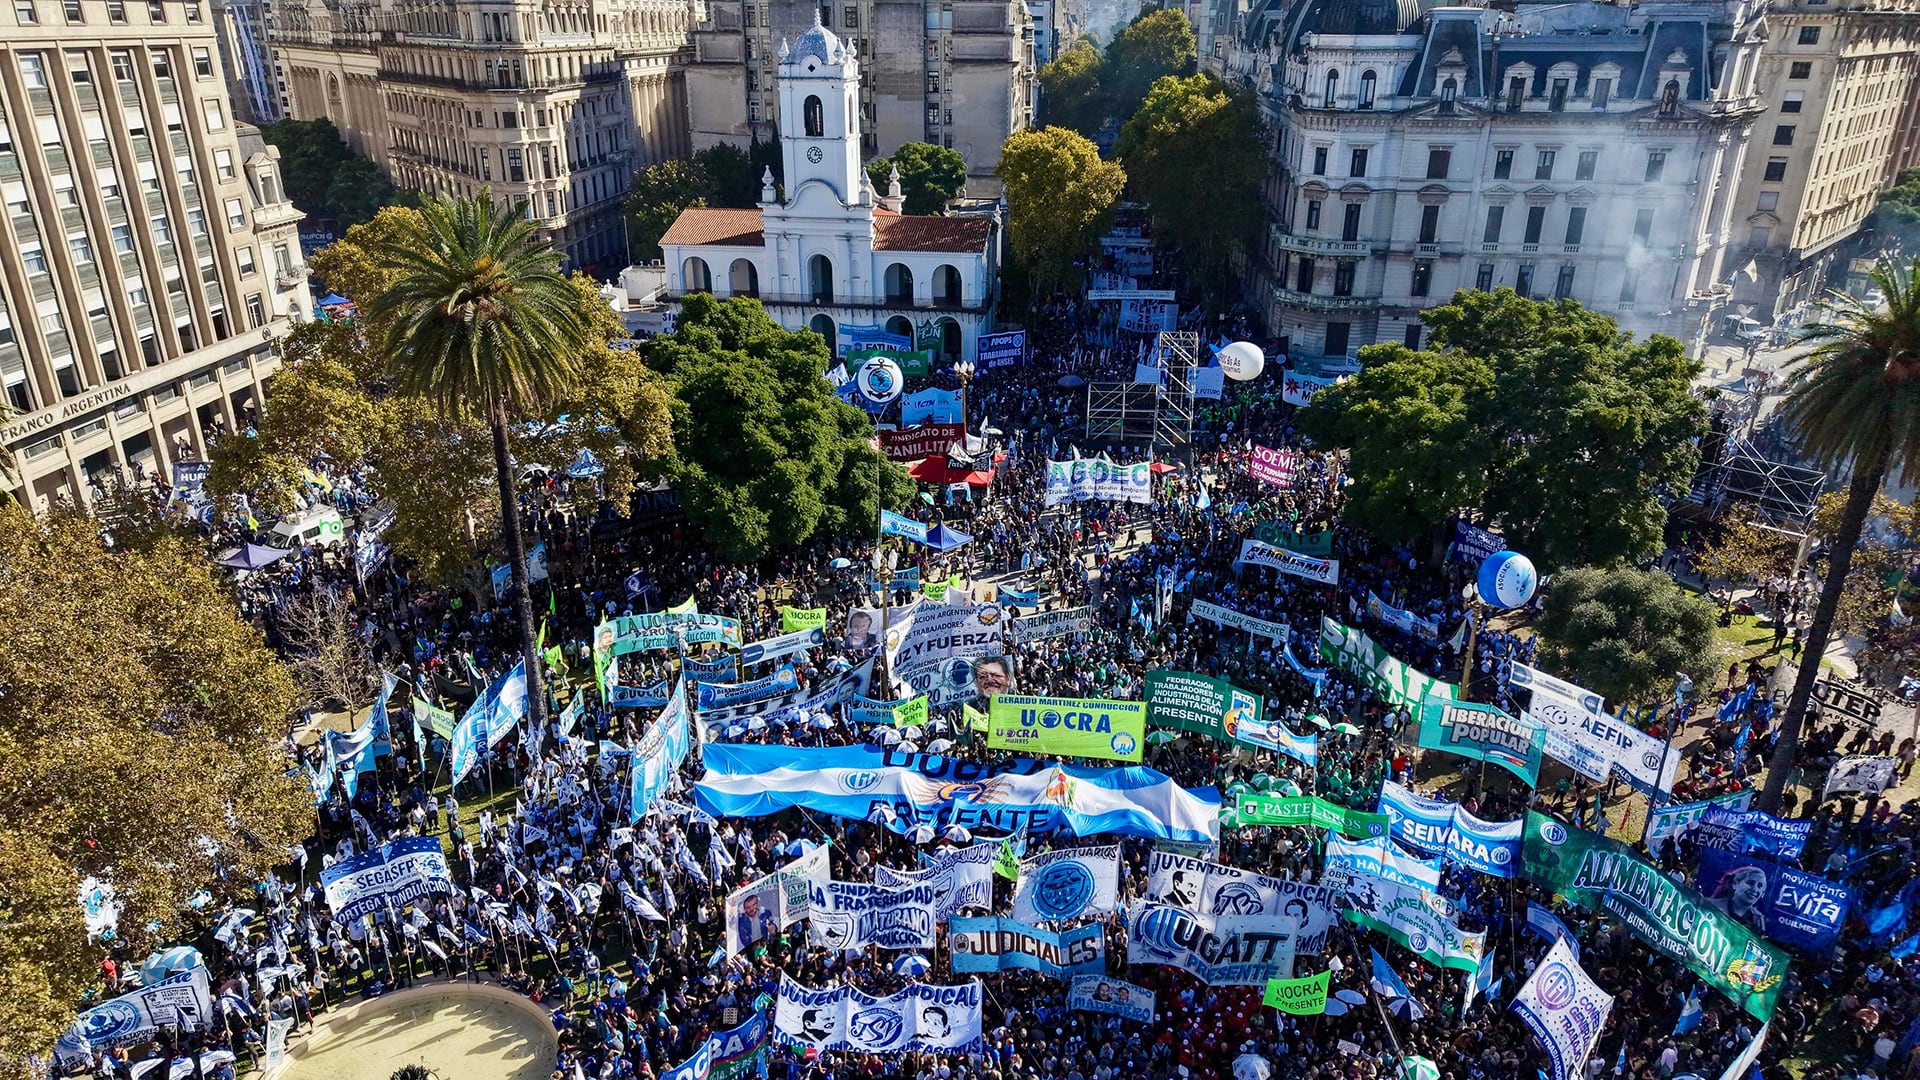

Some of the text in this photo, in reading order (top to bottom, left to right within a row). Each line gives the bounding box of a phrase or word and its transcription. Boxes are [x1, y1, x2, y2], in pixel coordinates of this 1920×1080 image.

[1, 383, 132, 441] FRANCO ARGENTINA
[941, 428, 956, 437] DE
[1253, 445, 1296, 471] SOEME
[1047, 461, 1150, 488] AGOEC
[791, 611, 821, 620] UOCRA
[937, 608, 977, 622] ARGENTINA
[1245, 618, 1286, 638] PRESENTE
[912, 620, 965, 638] TRABAJADORES
[894, 631, 1002, 668] UZ Y FUERZA
[1321, 616, 1452, 702] SMATA
[1153, 682, 1214, 698] TRABAJADORES
[1339, 651, 1417, 713] PRESENT
[1829, 673, 1856, 689] ECHO
[946, 689, 977, 701] UOCRA
[998, 697, 1037, 705] GERARDO
[1154, 689, 1200, 702] INDUSTRIAS
[1021, 709, 1112, 733] UOCRA
[1153, 706, 1219, 728] PRESENTE
[1450, 723, 1530, 756] POPULAR
[1580, 716, 1633, 749] AEFIP
[1567, 754, 1602, 778] AIRES
[867, 800, 1050, 834] PRESENTE
[1264, 802, 1362, 830] PASTELEROS
[1727, 813, 1811, 834] BERAZATEGUI
[1402, 819, 1490, 863] SEIVARA
[1697, 832, 1727, 850] EVIT
[1755, 827, 1806, 841] movimiento
[1461, 856, 1489, 871] VIDRIO
[807, 879, 826, 908] LA
[834, 885, 933, 911] FRATERNIDAD
[1151, 852, 1243, 879] JUVENTUD
[1256, 876, 1337, 912] SINDICAL
[1781, 872, 1847, 899] movimiento
[338, 899, 384, 925] ORTEGA
[1573, 849, 1731, 976] ALIMENTACIÓN
[1775, 885, 1841, 924] Evita
[858, 908, 930, 941] MATURANO
[1381, 896, 1461, 951] ALIMENTACIÓN
[1606, 897, 1689, 957] ILIAL BUENOS AIRES
[1778, 916, 1818, 934] QUILMES
[970, 930, 1098, 967] JUDICIALES
[1173, 917, 1291, 966] UGATT
[1186, 954, 1280, 986] PRESENTE
[780, 979, 980, 1007] JUVENTUD SINDICAL
[1274, 996, 1326, 1011] PRESENTE
[1275, 980, 1324, 1000] UOCRA
[1514, 1005, 1546, 1040] MUJERES
[1560, 1015, 1583, 1063] TRABAJO
